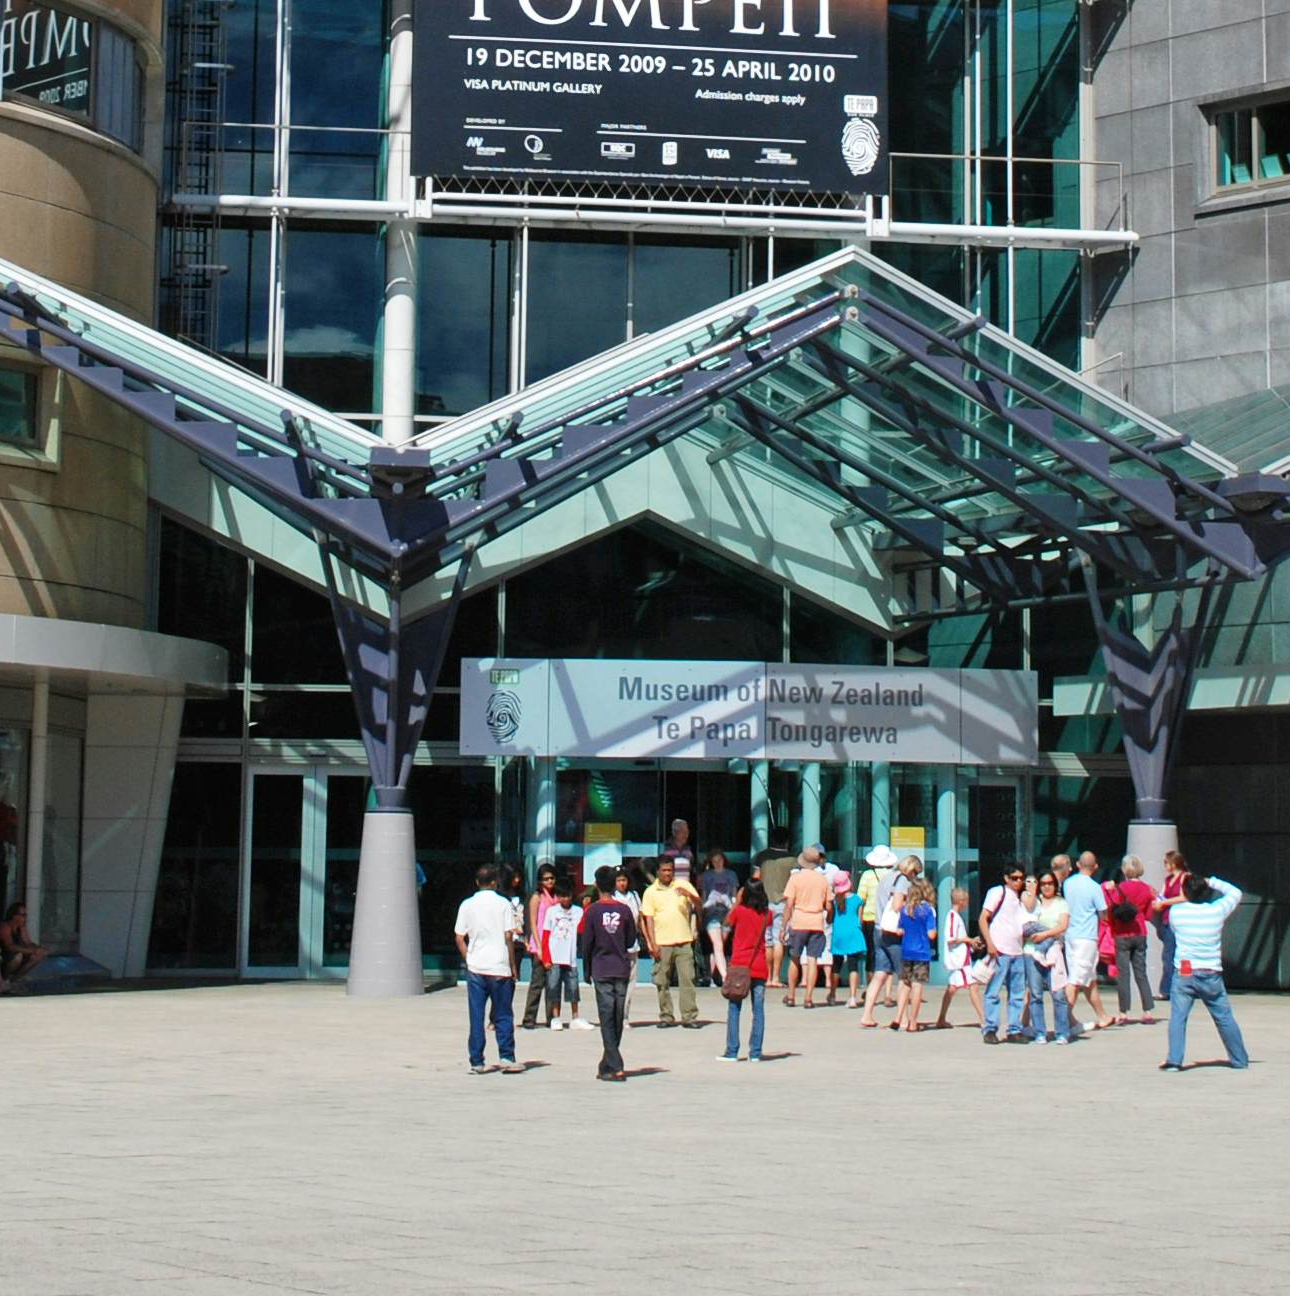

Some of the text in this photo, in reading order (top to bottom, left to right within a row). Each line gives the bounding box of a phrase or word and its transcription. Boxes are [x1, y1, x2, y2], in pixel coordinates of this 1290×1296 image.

[466, 47, 488, 66] 19
[495, 48, 612, 72] DECEMBER
[618, 54, 667, 74] 2009
[691, 57, 715, 77] 25
[721, 60, 782, 81] APRIL
[788, 63, 836, 84] 2010
[463, 78, 603, 95] VISA PLATINUM GALLERY
[695, 88, 807, 107] Admission charges apply
[705, 147, 731, 160] VISA
[618, 676, 924, 707] Museum of New Zealand
[652, 715, 899, 748] Te Papa Tongarewa
